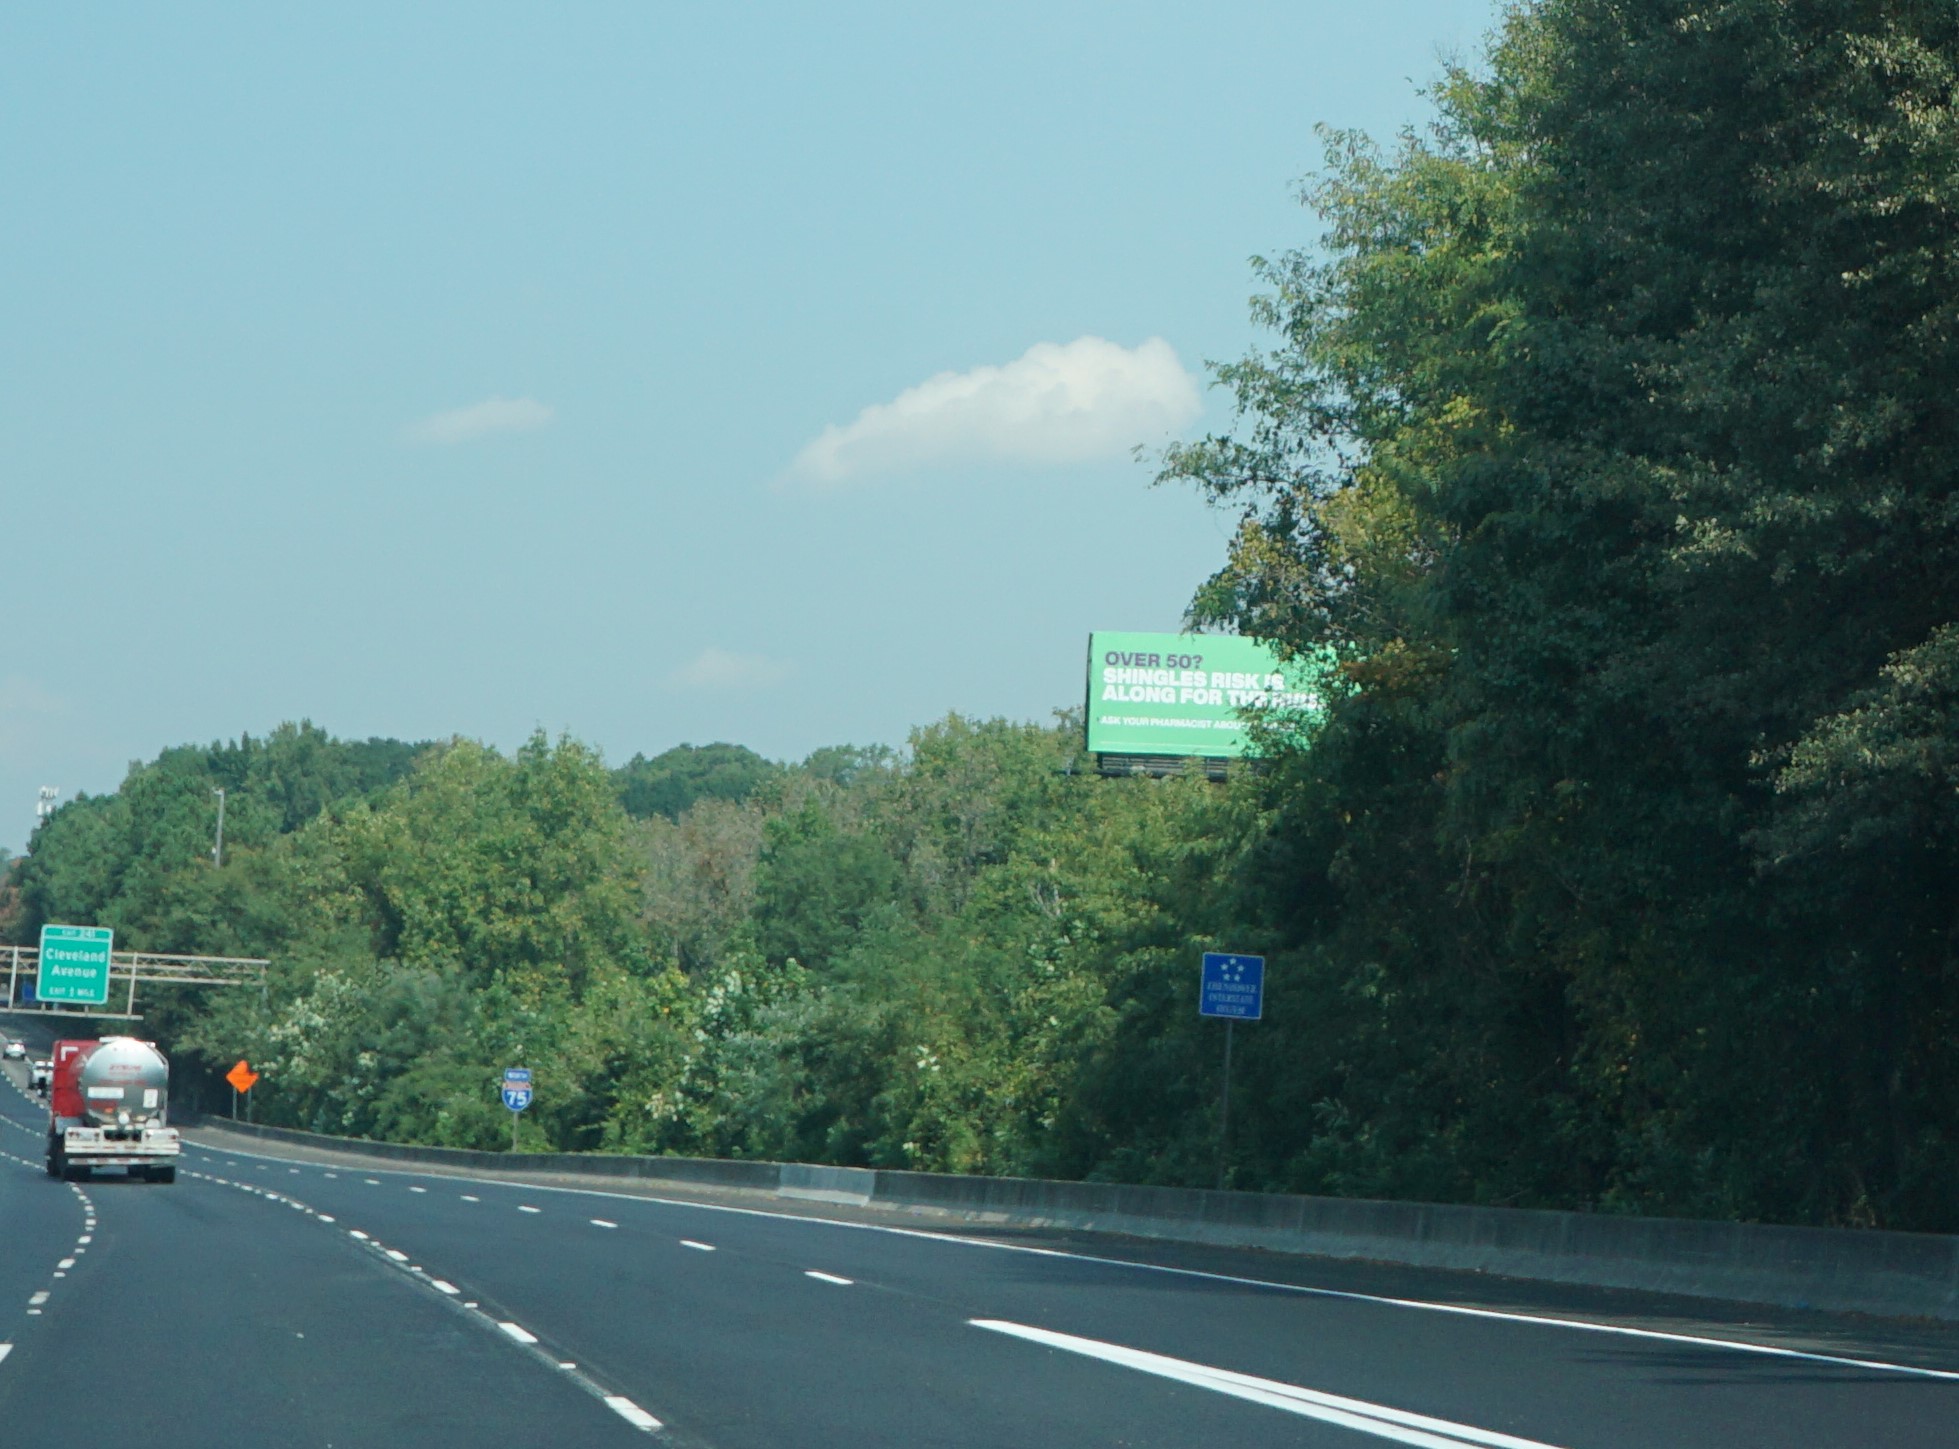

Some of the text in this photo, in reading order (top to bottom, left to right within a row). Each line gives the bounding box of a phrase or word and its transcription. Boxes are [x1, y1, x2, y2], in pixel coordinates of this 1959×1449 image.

[1105, 651, 1204, 669] OVER 50?
[1103, 667, 1208, 688] SHINGLES
[1211, 671, 1260, 690] RISK
[1102, 684, 1176, 704] ALONG
[1180, 688, 1222, 705] FOR
[1101, 715, 1121, 725] ASK
[1122, 716, 1149, 726] YOUR
[1150, 718, 1212, 729] PHARMACIST
[45, 947, 106, 963] Cleveland
[51, 964, 97, 978] Avenue
[507, 1091, 527, 1106] 75
